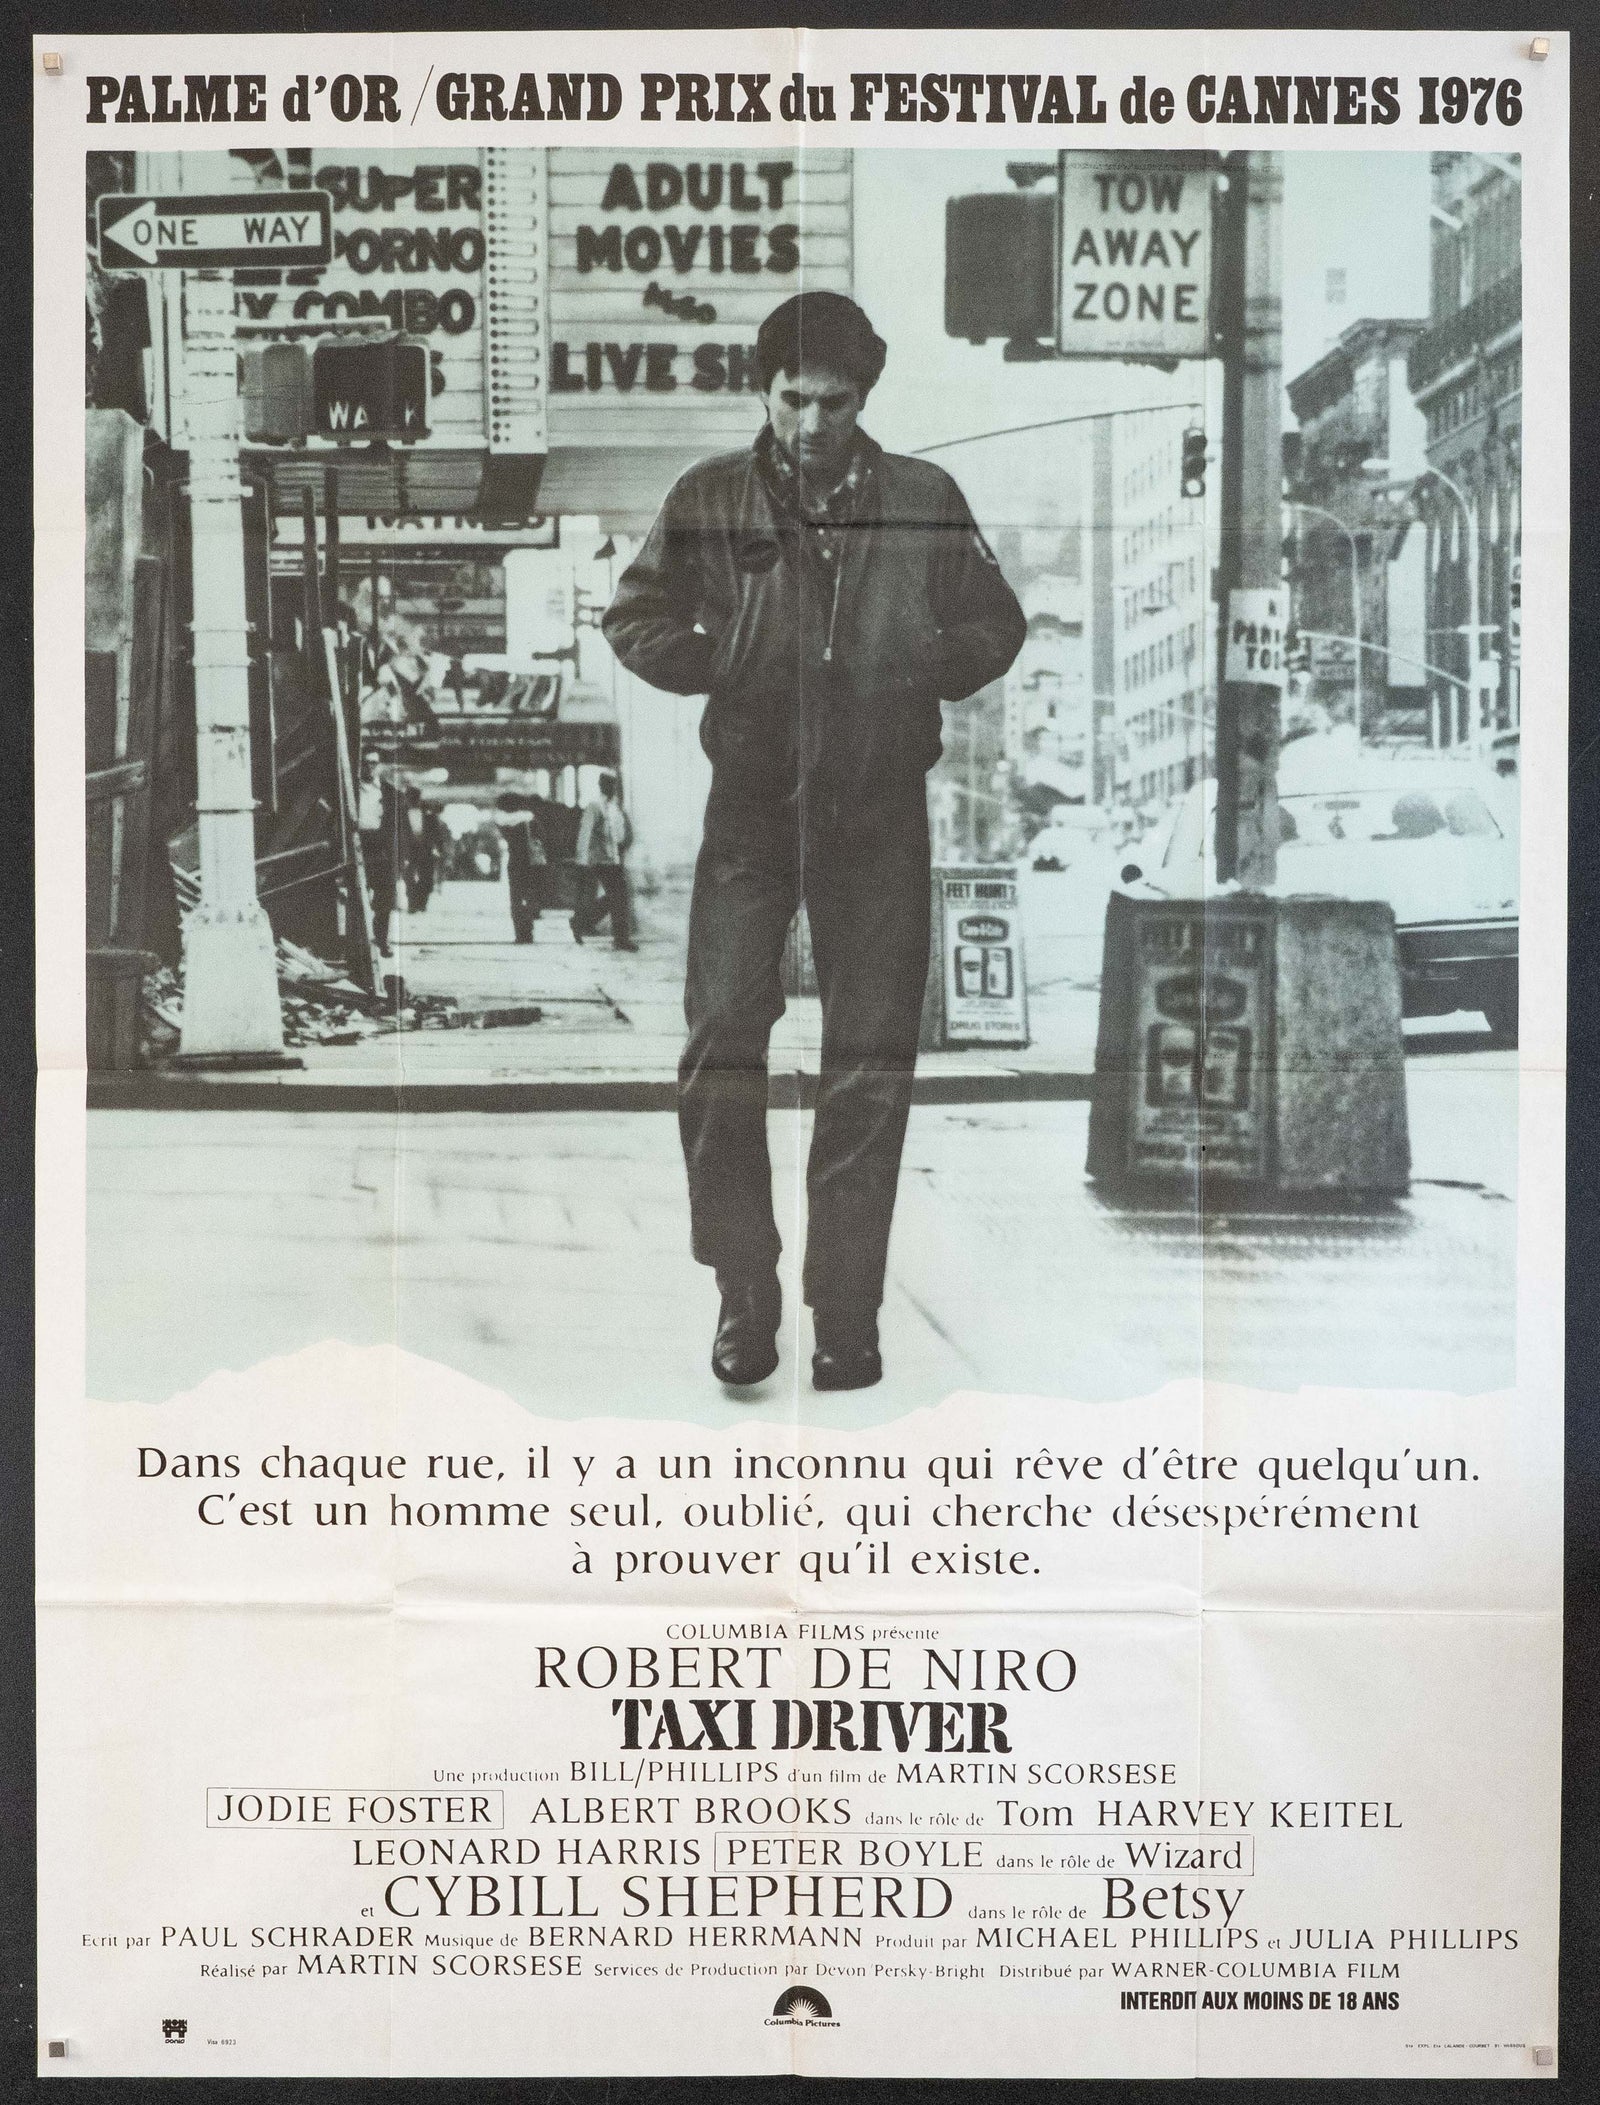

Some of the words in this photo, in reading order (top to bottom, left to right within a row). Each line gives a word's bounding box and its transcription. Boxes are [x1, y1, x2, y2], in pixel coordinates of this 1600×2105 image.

[86, 75, 266, 123] PALME
[283, 74, 401, 122] d'OR
[436, 73, 622, 121] GRAND
[641, 73, 771, 122] PRIX
[780, 73, 836, 122] du
[850, 73, 1106, 124] FESTIVAL
[1120, 76, 1174, 124] de
[1187, 74, 1400, 125] CANNES
[1419, 77, 1522, 126] 1976
[315, 164, 483, 212] SUPER
[601, 161, 794, 212] ADULT
[1093, 173, 1185, 214] TOW
[132, 219, 198, 246] ONE
[243, 215, 309, 243] WAY
[576, 224, 800, 274] MOVIES
[1071, 228, 1201, 268] AWAY
[1072, 282, 1200, 323] ZONE
[551, 341, 678, 392] LIVE
[692, 342, 763, 392] SH
[328, 402, 416, 430] WAK
[138, 1448, 240, 1478] Dans
[261, 1445, 406, 1486] chaque
[428, 1455, 504, 1481] rue,
[528, 1446, 549, 1478] il
[573, 1457, 594, 1486] y
[616, 1456, 636, 1479] a
[660, 1456, 710, 1479] un
[735, 1448, 905, 1479] inconnu
[928, 1448, 992, 1487] qui
[1016, 1448, 1102, 1480] rêve
[1123, 1447, 1237, 1480] d'être
[1259, 1448, 1478, 1488] quelqu'un.
[198, 1493, 292, 1526] C'est
[315, 1503, 366, 1526] un
[391, 1494, 549, 1526] homme
[570, 1493, 661, 1528] seul,
[684, 1494, 823, 1528] oublié,
[847, 1496, 909, 1534] qui
[933, 1494, 1091, 1527] cherche
[1113, 1495, 1419, 1535] désespérément
[572, 1542, 592, 1574] à
[616, 1551, 780, 1581] prouver
[800, 1542, 889, 1582] qu'il
[912, 1543, 1039, 1575] existe.
[667, 1624, 787, 1639] COLUMBIA
[799, 1624, 864, 1640] FILMS
[873, 1626, 939, 1641] présente
[536, 1646, 781, 1689] ROBERT
[811, 1648, 890, 1689] DE
[924, 1649, 1076, 1692] NIRO
[612, 1699, 757, 1750] TAXI
[771, 1700, 1012, 1753] DRIVER
[433, 1769, 465, 1783] Une
[472, 1769, 559, 1784] production
[571, 1758, 778, 1788] BILL/PHILLIPS
[788, 1769, 822, 1782] d'un
[830, 1770, 860, 1782] film
[868, 1770, 886, 1783] de
[897, 1763, 1016, 1783] MARTIN
[1028, 1764, 1175, 1784] SCORSESE
[218, 1795, 330, 1822] JODIE
[349, 1797, 491, 1823] FOSTER
[531, 1798, 679, 1823] ALBERT
[696, 1798, 850, 1824] BROOKS
[865, 1812, 902, 1825] dans
[910, 1812, 922, 1825] le
[930, 1813, 959, 1826] rôle
[966, 1813, 983, 1826] de
[997, 1801, 1072, 1826] Tom
[1099, 1801, 1254, 1827] HARVEY
[1271, 1802, 1402, 1828] KEITEL
[354, 1839, 540, 1865] LEONARD
[558, 1839, 700, 1865] HARRIS
[728, 1839, 842, 1865] PETER
[860, 1840, 982, 1867] BOYLE
[997, 1855, 1033, 1868] dans
[1041, 1855, 1053, 1868] le
[1061, 1855, 1090, 1868] rôle
[1097, 1855, 1114, 1868] de
[1125, 1841, 1241, 1869] Wizard
[361, 1907, 373, 1917] et
[385, 1875, 598, 1917] CYBILL
[623, 1875, 952, 1918] SHEPHERD
[968, 1906, 1005, 1919] dans
[1013, 1906, 1025, 1919] le
[1033, 1906, 1062, 1919] rôle
[1069, 1906, 1086, 1919] de
[1103, 1878, 1244, 1928] Betsy
[83, 1934, 117, 1946] Ecrit
[127, 1937, 150, 1949] par
[162, 1927, 237, 1947] PAUL
[252, 1927, 413, 1947] SCHRADER
[425, 1935, 493, 1949] Musique
[500, 1933, 518, 1946] de
[530, 1927, 672, 1946] BERNARD
[689, 1926, 861, 1947] HERRMANN
[876, 1935, 933, 1947] Produit
[943, 1939, 966, 1950] par
[977, 1927, 1116, 1948] MICHAEL
[1132, 1928, 1258, 1948] PHILLIPS
[1268, 1939, 1280, 1949] et
[1290, 1929, 1374, 1949] JULIA
[1391, 1929, 1518, 1950] PHILLIPS
[201, 1964, 255, 1977] Réalisé
[263, 1966, 287, 1978] par
[298, 1954, 416, 1975] MARTIN
[433, 1955, 581, 1976] SCORSESE
[595, 1964, 658, 1976] Services
[665, 1963, 683, 1976] de
[691, 1963, 777, 1975] Production
[786, 1965, 808, 1977] par
[816, 1964, 865, 1976] Devon
[875, 1964, 984, 1980] Persky-Bright
[1000, 1965, 1072, 1977] Distribué
[1079, 1968, 1103, 1980] par
[1112, 1962, 1336, 1978] WARNER-COLUMBIA
[1348, 1963, 1399, 1978] FILM
[1121, 1991, 1197, 2010] INTERDIT
[1202, 1991, 1238, 2010] AUX
[1244, 1991, 1303, 2010] MOINS
[1309, 1992, 1331, 2010] DE
[1338, 1992, 1357, 2010] 18
[1362, 1992, 1399, 2010] ANS
[764, 2018, 803, 2026] Columbia
[805, 2019, 840, 2027] Pictures
